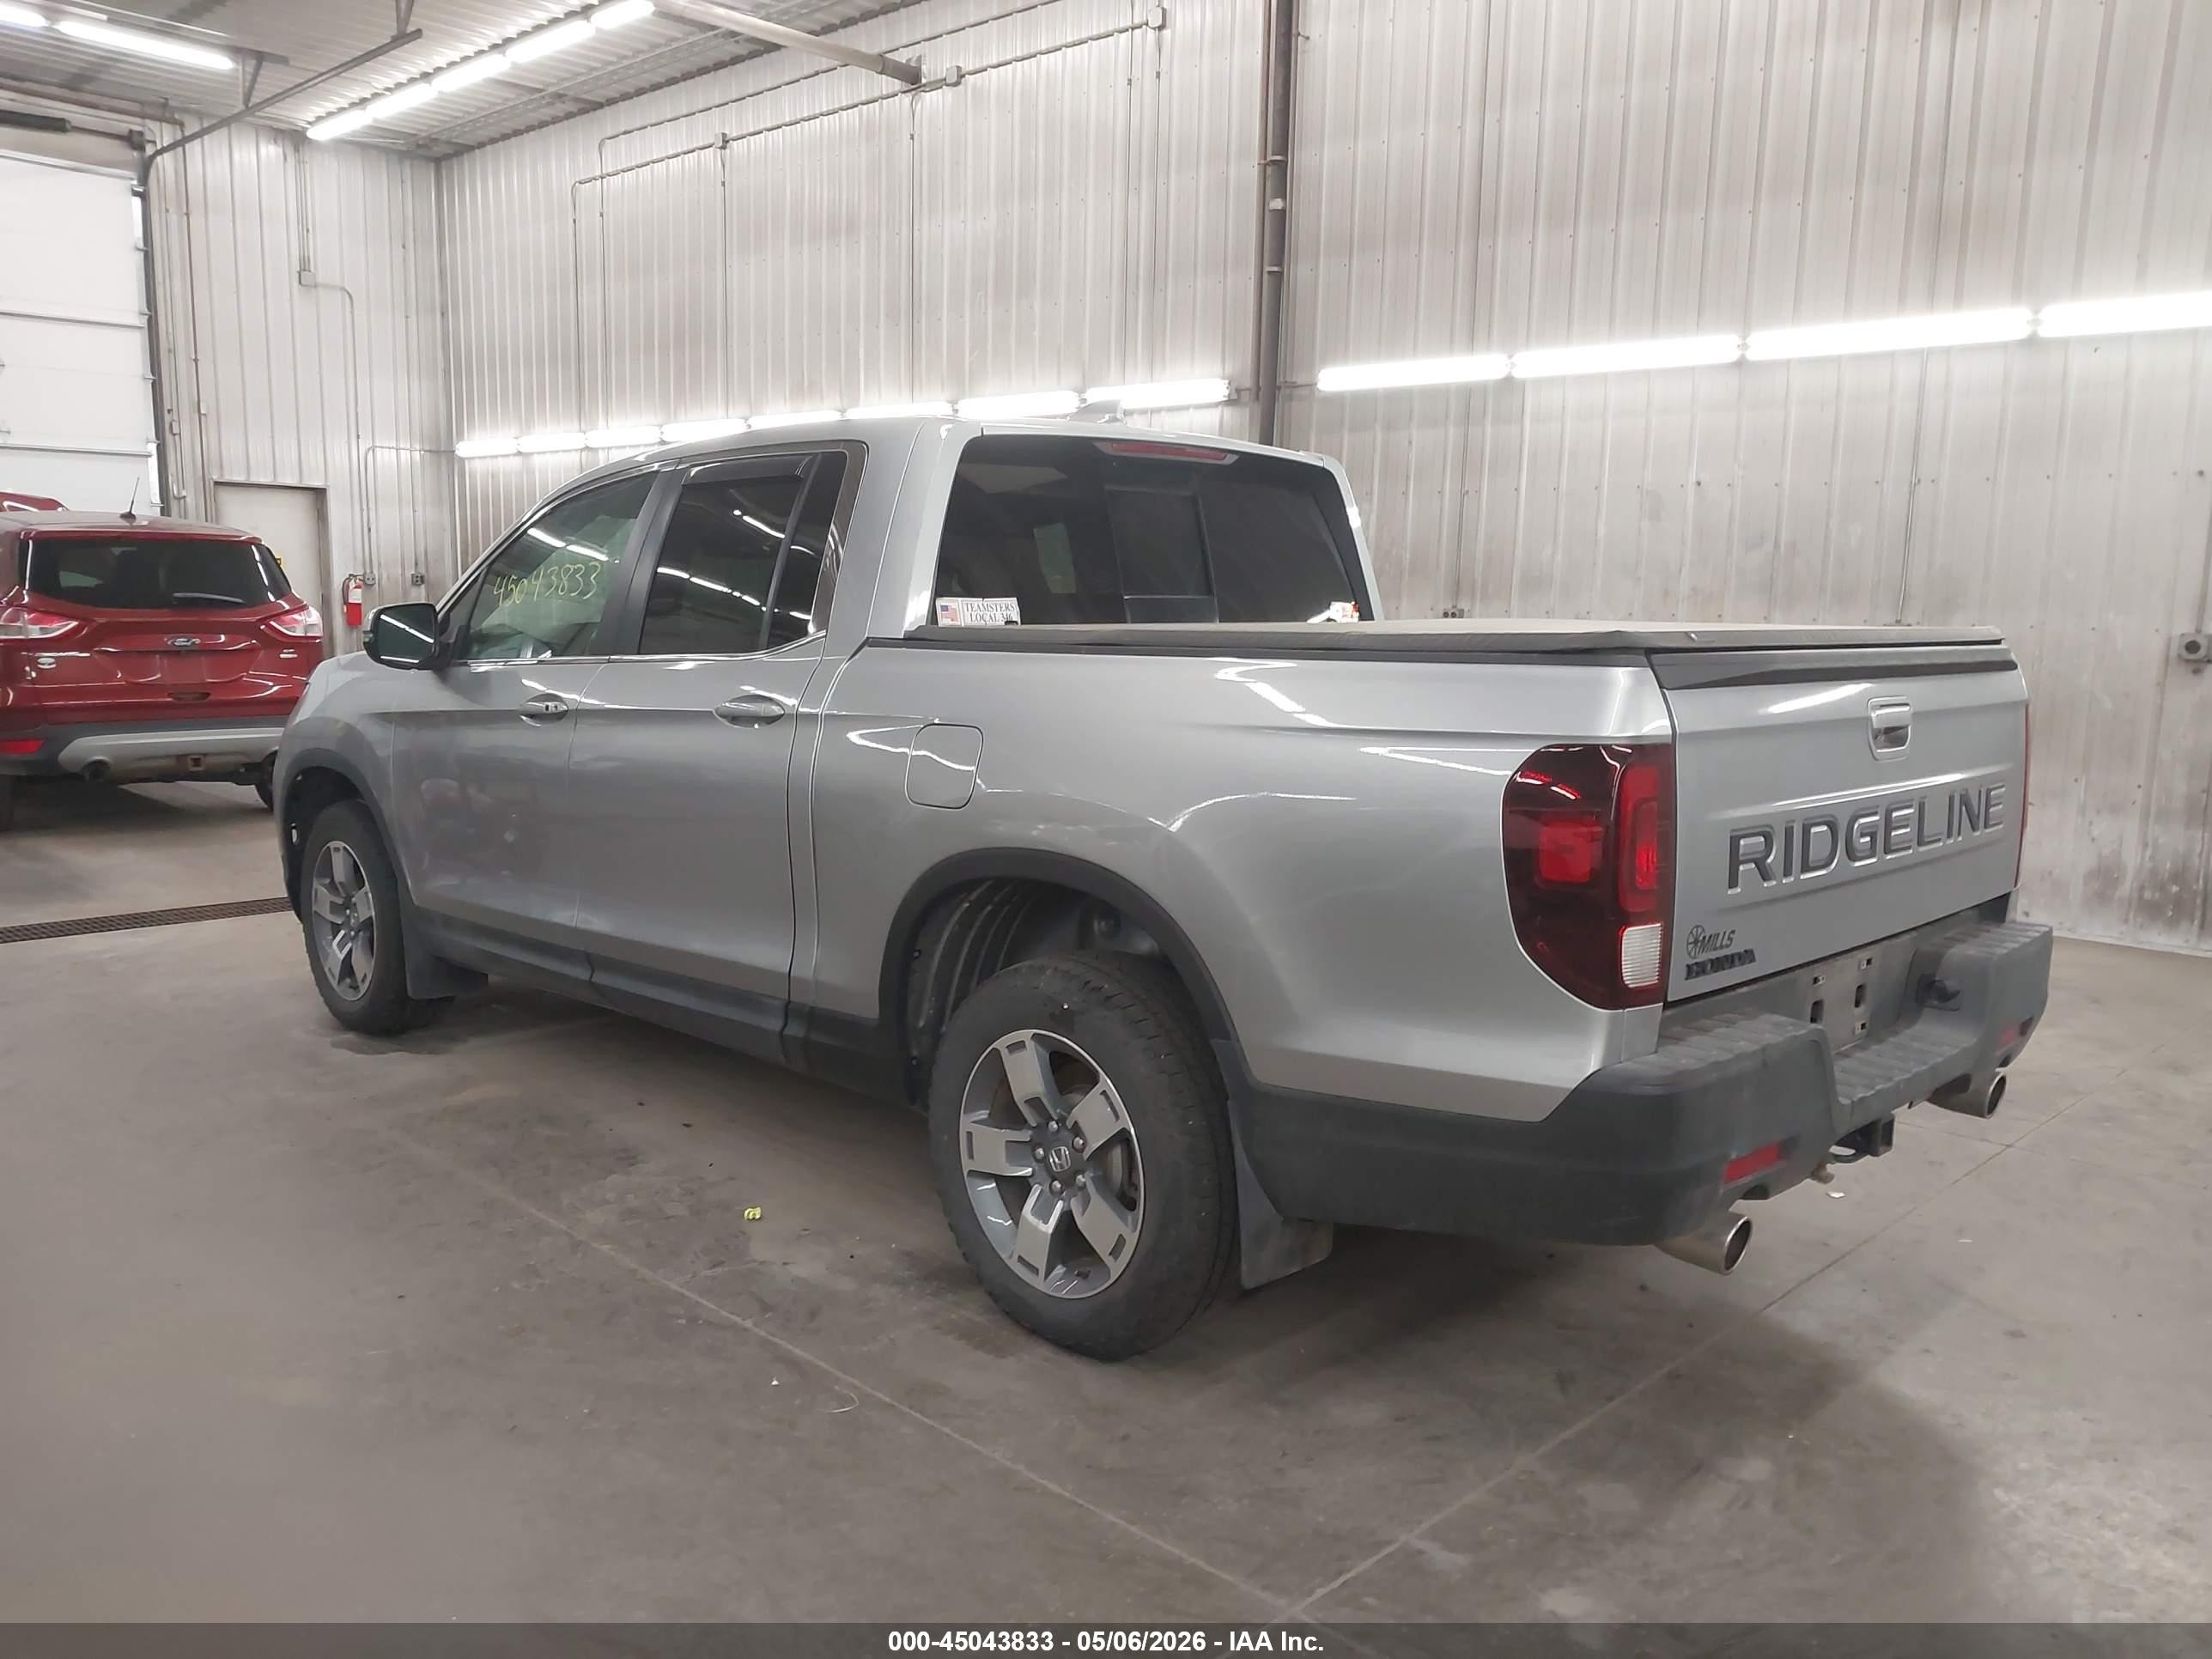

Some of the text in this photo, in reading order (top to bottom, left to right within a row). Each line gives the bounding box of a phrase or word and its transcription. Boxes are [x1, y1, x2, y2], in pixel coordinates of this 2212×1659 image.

[493, 562, 601, 608] 45043833
[964, 602, 1016, 612] TEAMSTERS
[969, 612, 1000, 623] LOCAL
[1727, 783, 2007, 895] RIDGELINE
[1697, 929, 1736, 956] MILLS
